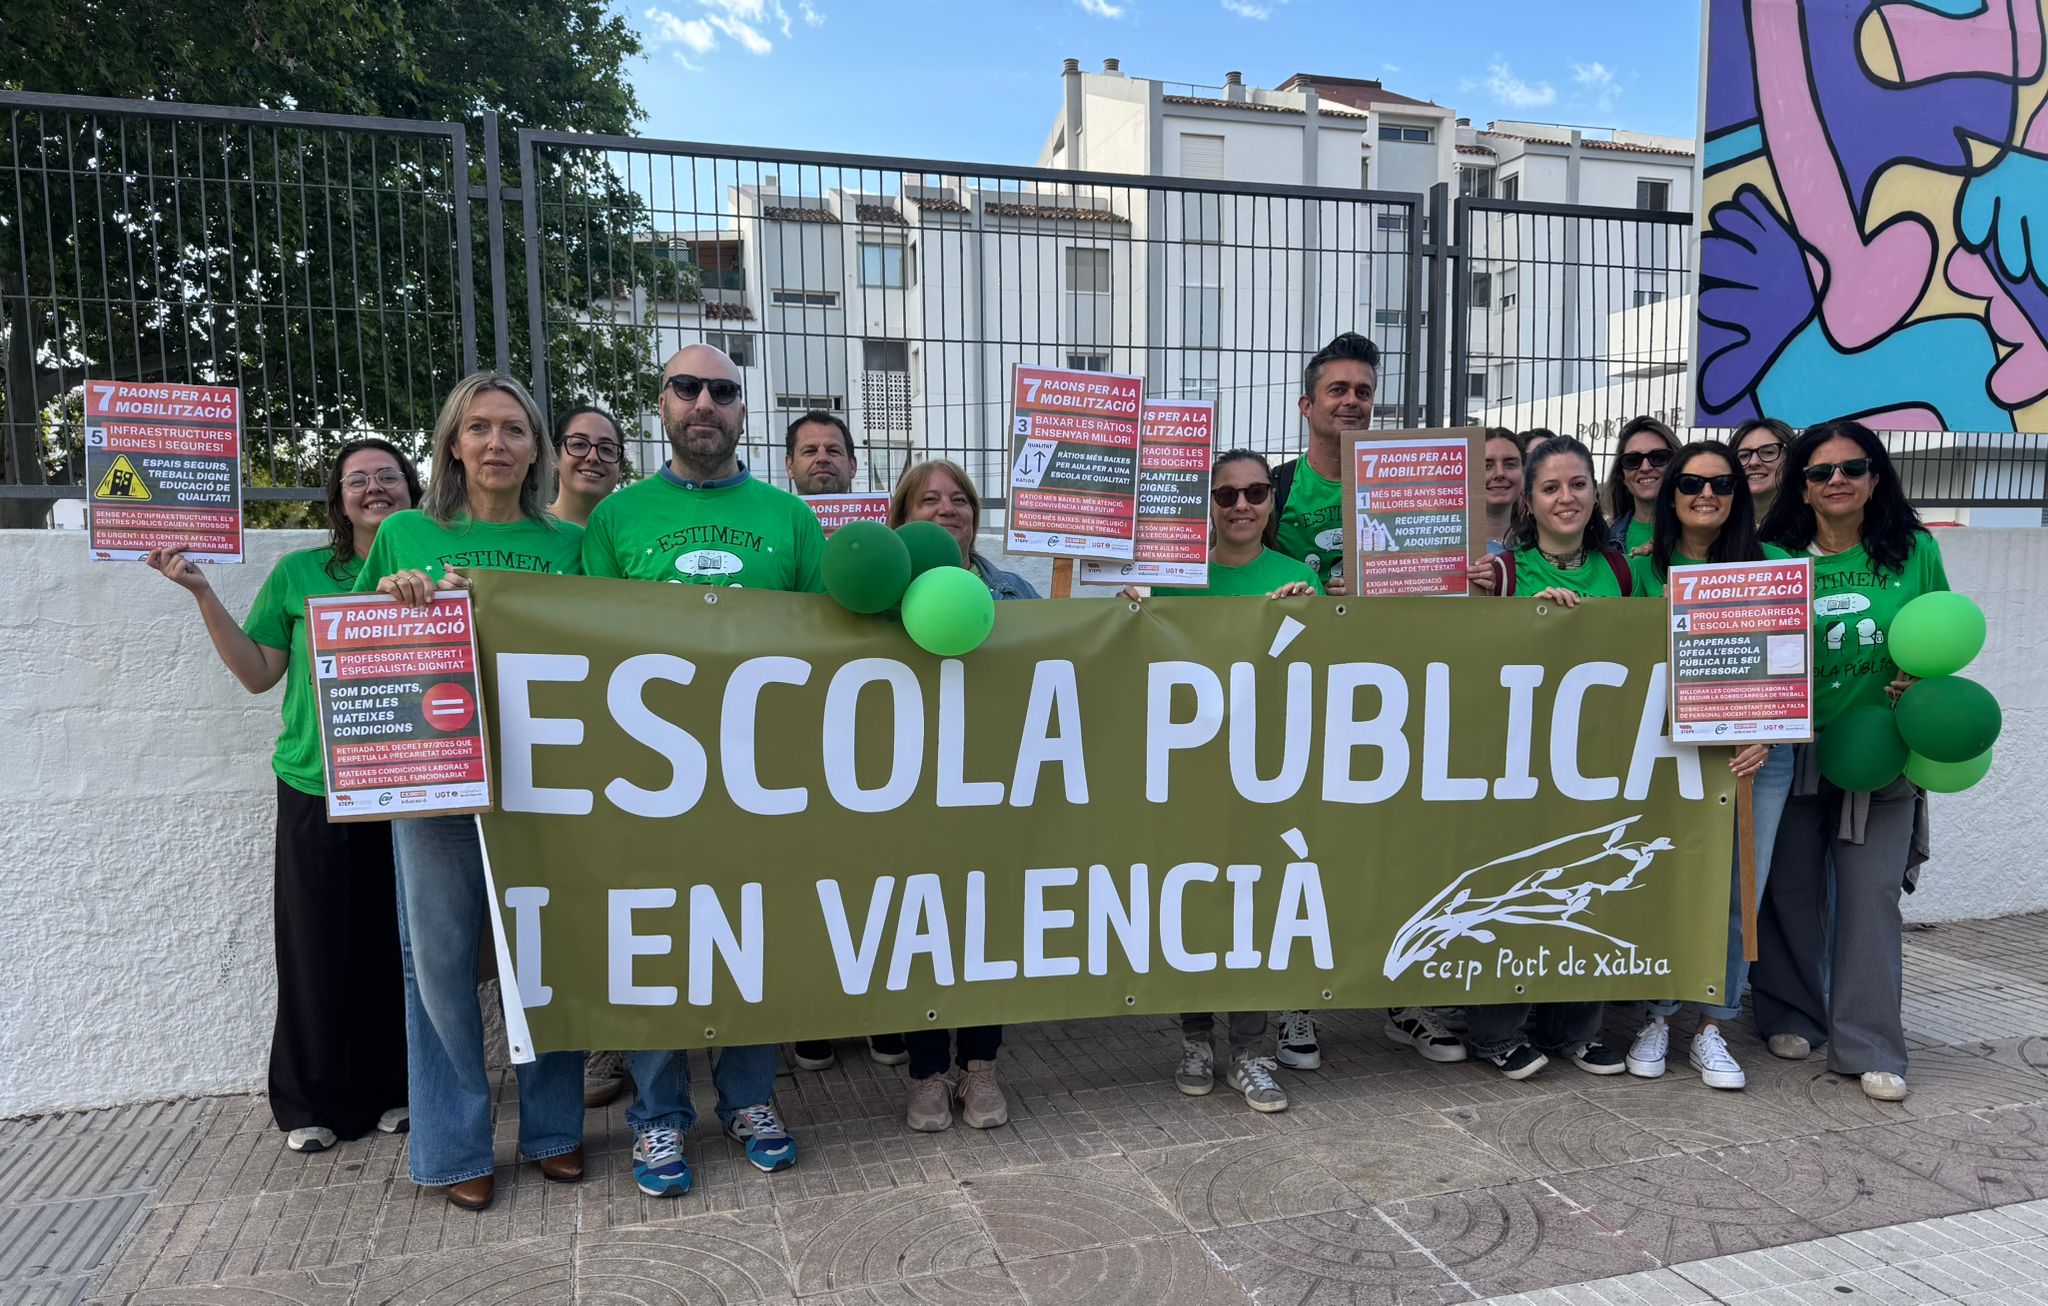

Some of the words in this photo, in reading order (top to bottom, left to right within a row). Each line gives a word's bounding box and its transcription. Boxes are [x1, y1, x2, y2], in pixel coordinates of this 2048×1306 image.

[119, 387, 169, 399] RAONS
[172, 390, 199, 400] PER
[201, 392, 212, 401] A
[214, 393, 231, 403] LA
[1023, 379, 1041, 402] 7
[1044, 380, 1085, 392] RAONS
[1088, 384, 1108, 394] PER
[1112, 387, 1119, 396] A
[1122, 388, 1136, 398] LA
[93, 386, 115, 411] 7
[1041, 394, 1136, 412] MOBILITZACIÓ
[116, 402, 232, 419] MOBILITZACIÓ
[1158, 412, 1180, 422] PER
[1182, 412, 1191, 422] A
[1193, 413, 1207, 422] LA
[1018, 419, 1027, 432] 3
[1036, 416, 1073, 427] BAIXAR
[1076, 419, 1094, 429] LES
[1097, 420, 1135, 434] RÀTIOS,
[1142, 426, 1207, 437] ILITZACIÓ
[91, 430, 103, 444] 5
[110, 425, 232, 440] INFRAESTRUCTURES
[1035, 429, 1089, 440] ENSENYAR
[1092, 432, 1131, 444] MILLOR!
[111, 438, 156, 448] DIGNES
[159, 440, 162, 449] I
[165, 441, 224, 452] SEGURES!
[1058, 451, 1085, 460] RÀTIOS
[1086, 453, 1102, 461] MÉS
[1104, 456, 1131, 464] BAIXES
[1161, 459, 1204, 467] DOCENTS
[1381, 453, 1417, 463] RAONS
[1420, 452, 1438, 462] PER
[1441, 452, 1448, 461] A
[1451, 451, 1462, 461] LA
[143, 459, 180, 468] ESPAIS
[183, 460, 229, 471] SEGURS,
[1071, 463, 1090, 471] AULA
[1362, 455, 1379, 478] 7
[1378, 463, 1463, 478] MOBILITZACIÓ
[148, 470, 193, 480] TREBALL
[197, 471, 230, 481] DIGNE
[1051, 472, 1081, 480] ESCOLA
[1093, 475, 1130, 484] QUALITAT!
[1140, 473, 1198, 482] PLANTILLES
[160, 480, 214, 491] EDUCACIÓ
[216, 483, 230, 491] DE
[1140, 484, 1180, 493] DIGNES,
[178, 492, 231, 502] QUALITAT!
[1371, 488, 1389, 498] MÉS
[1391, 490, 1401, 498] DE
[1404, 489, 1412, 497] 18
[1415, 488, 1435, 496] ANYS
[1438, 487, 1463, 495] SENSE
[1140, 495, 1202, 504] CONDICIONS
[1361, 494, 1366, 506] 1
[1371, 500, 1415, 509] MILLORES
[1417, 498, 1464, 507] SALARIALS
[811, 504, 840, 513] AONS
[873, 504, 886, 512] LA
[1302, 505, 1342, 528] ESTI
[1395, 515, 1449, 525] RECUPEREM
[1395, 527, 1431, 536] NOSTRE
[1433, 525, 1462, 534] PODER
[657, 524, 765, 553] ESTIMEM
[1404, 536, 1460, 547] ADQUISITIU!
[1701, 574, 1745, 585] RAONS
[1748, 572, 1772, 582] PER
[1774, 572, 1783, 581] A
[1787, 570, 1802, 580] LA
[1814, 571, 1890, 590] TIMEM
[1679, 577, 1698, 600] 7
[1698, 584, 1803, 599] MOBILITZACIÓ
[347, 609, 398, 622] RAONS
[401, 607, 429, 619] PER
[432, 606, 442, 617] A
[445, 605, 463, 616] LA
[1693, 611, 1719, 620] PROU
[1721, 607, 1804, 618] SOBRECÀRREGA,
[320, 612, 343, 640] 7
[345, 619, 465, 640] MOBILITZACIÓ
[1677, 617, 1687, 630] 4
[1693, 621, 1739, 630] L'ESCOLA
[1741, 620, 1755, 628] NO
[1758, 619, 1776, 627] POT
[1779, 617, 1800, 626] MÉS
[1693, 637, 1750, 647] PAPERASSA
[340, 652, 414, 664] PROFESSORAT
[417, 650, 456, 660] EXPERT
[459, 649, 462, 658] I
[1679, 648, 1712, 657] OFEGA
[1714, 646, 1760, 655] L'ESCOLA
[322, 660, 333, 674] 7
[341, 664, 416, 676] ESPECIALISTA:
[419, 660, 465, 671] DIGNITAT
[1679, 657, 1720, 667] PÚBLICA
[1741, 656, 1760, 664] SEU
[1679, 667, 1750, 677] PROFESSORAT
[330, 687, 359, 698] SOM
[361, 683, 423, 696] DOCENTS,
[331, 700, 373, 710] VOLEM
[376, 697, 398, 708] LES
[333, 711, 394, 724] MATEIXES
[495, 652, 1089, 818] ESCOLA
[1145, 615, 1704, 816] PÚBLICA
[334, 723, 413, 737] CONDICIONS
[336, 746, 375, 755] RETIRADA
[392, 743, 422, 751] DECRET
[337, 754, 376, 763] PERPETUA
[389, 750, 440, 759] PRECARIETAT
[442, 748, 473, 756] DOCENT
[435, 791, 451, 799] UGT
[504, 886, 553, 1009] I
[607, 882, 765, 1007] EN
[816, 827, 1335, 996] VALENCIÀ
[1496, 945, 1550, 978] Port
[1558, 945, 1587, 976] de
